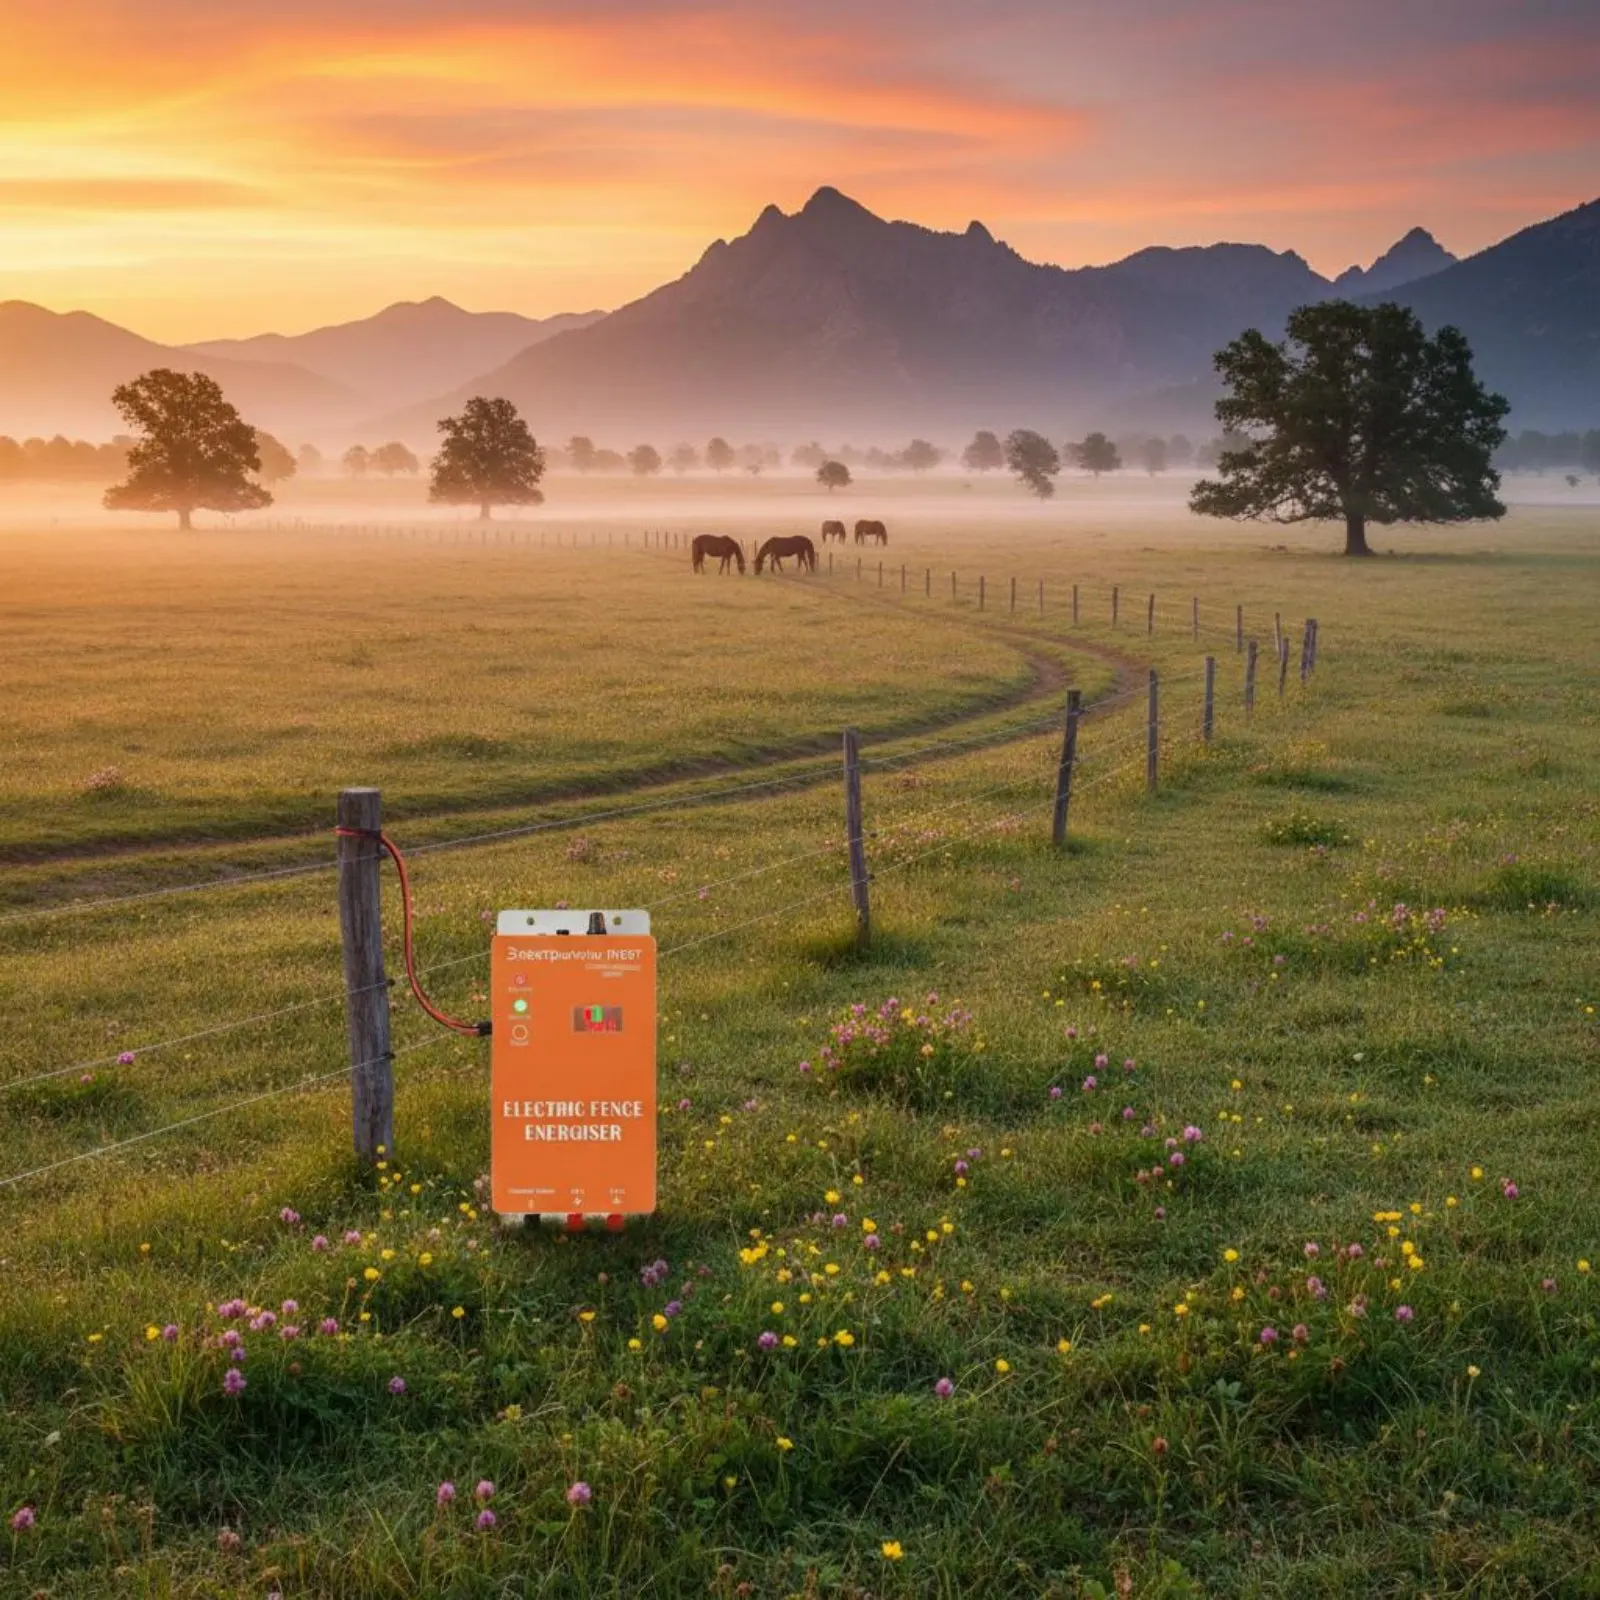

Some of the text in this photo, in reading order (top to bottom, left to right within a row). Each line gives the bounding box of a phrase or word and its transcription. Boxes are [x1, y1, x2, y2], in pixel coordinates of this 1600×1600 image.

[503, 1101, 643, 1118] ELECTRIC FENCE
[524, 1124, 622, 1142] ENERGISER
